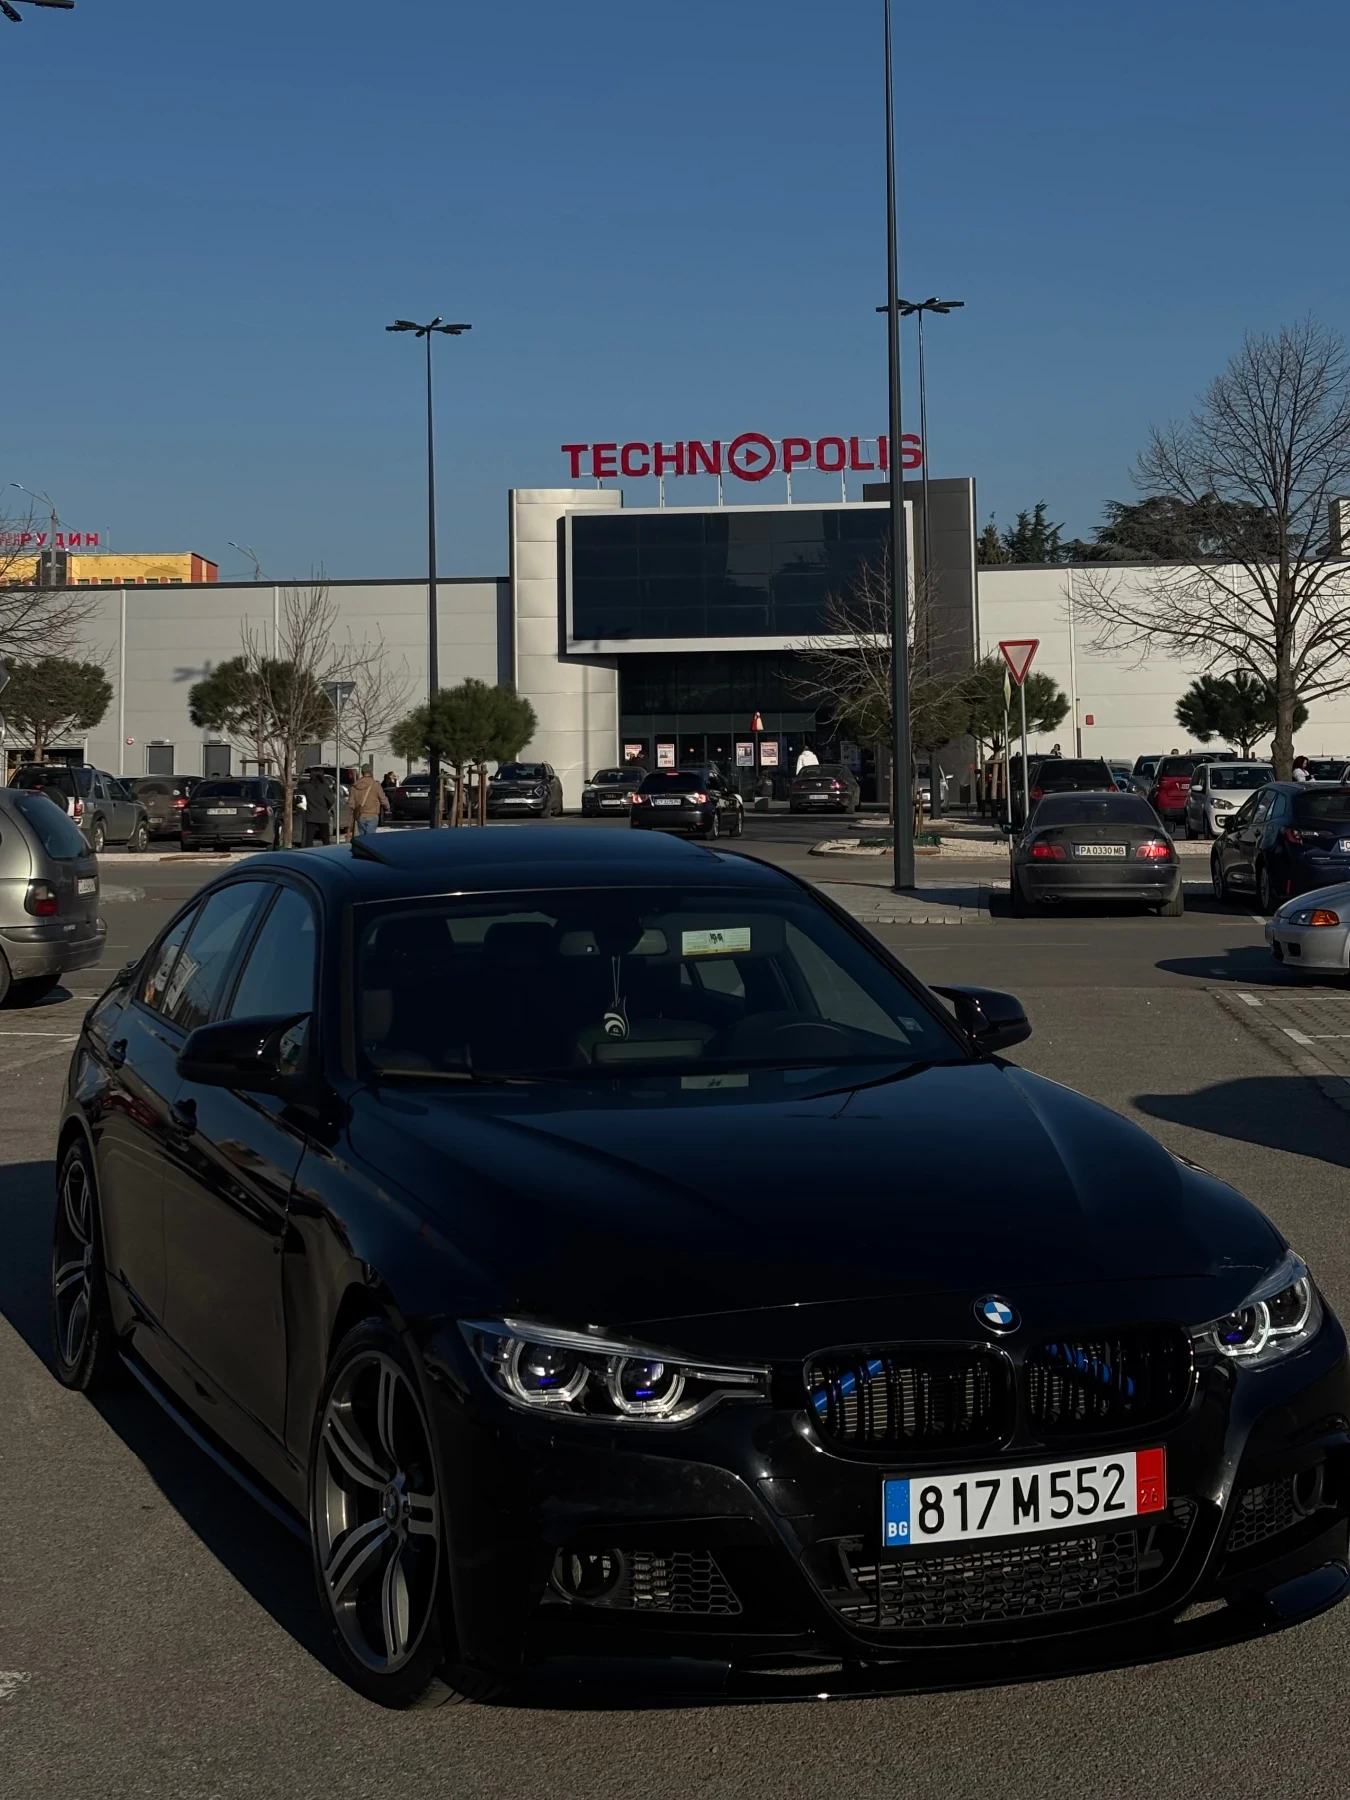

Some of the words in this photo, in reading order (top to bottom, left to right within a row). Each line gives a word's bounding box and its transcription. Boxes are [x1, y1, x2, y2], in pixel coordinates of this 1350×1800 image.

[1092, 846, 1112, 855] 0330
[918, 1479, 1001, 1534] 817
[1012, 1474, 1040, 1526] M
[1050, 1463, 1126, 1519] 552
[888, 1521, 908, 1537] BG
